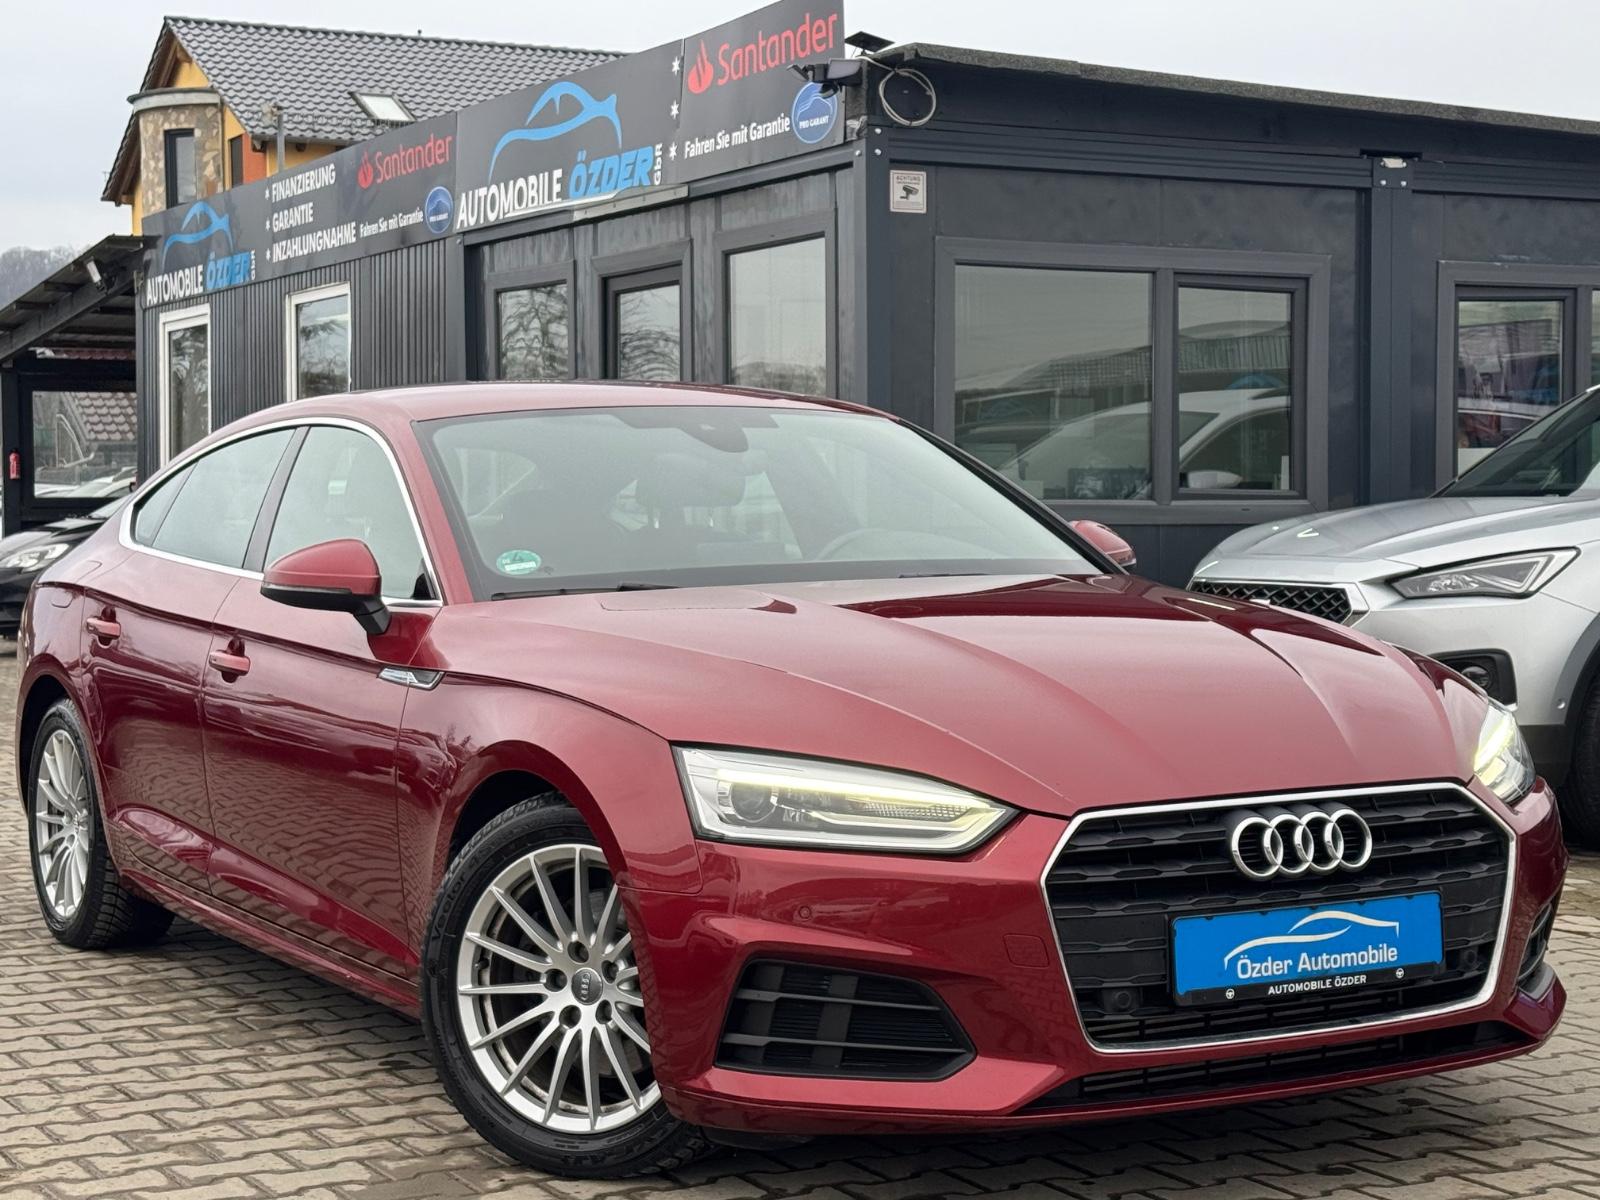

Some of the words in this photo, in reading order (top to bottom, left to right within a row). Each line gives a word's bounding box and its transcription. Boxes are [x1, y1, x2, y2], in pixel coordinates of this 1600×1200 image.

[716, 12, 838, 86] Santander
[684, 138, 715, 159] Fahren
[716, 130, 730, 150] Sie
[731, 124, 748, 146] mit
[749, 113, 790, 141] Garantie
[375, 134, 453, 184] Santander
[653, 143, 663, 186] GbR
[271, 163, 336, 203] FINANZIERUNG
[456, 168, 563, 229] AUTOMOBILE
[568, 146, 654, 200] ÖZDER
[272, 202, 314, 233] GARANTIE
[359, 222, 379, 238] Fahren
[378, 217, 388, 232] Sie
[389, 215, 398, 229] mit
[398, 207, 424, 227] Garantie
[272, 221, 357, 263] INZAHLUNGNAHME
[146, 265, 204, 306] AUTOMOBILE
[206, 251, 250, 289] ÖZDER
[1236, 955, 1293, 980] Özder
[1297, 943, 1398, 973] Automobile
[1268, 978, 1333, 996] AUTOMOBILE
[1334, 974, 1367, 989] ÖZDER
